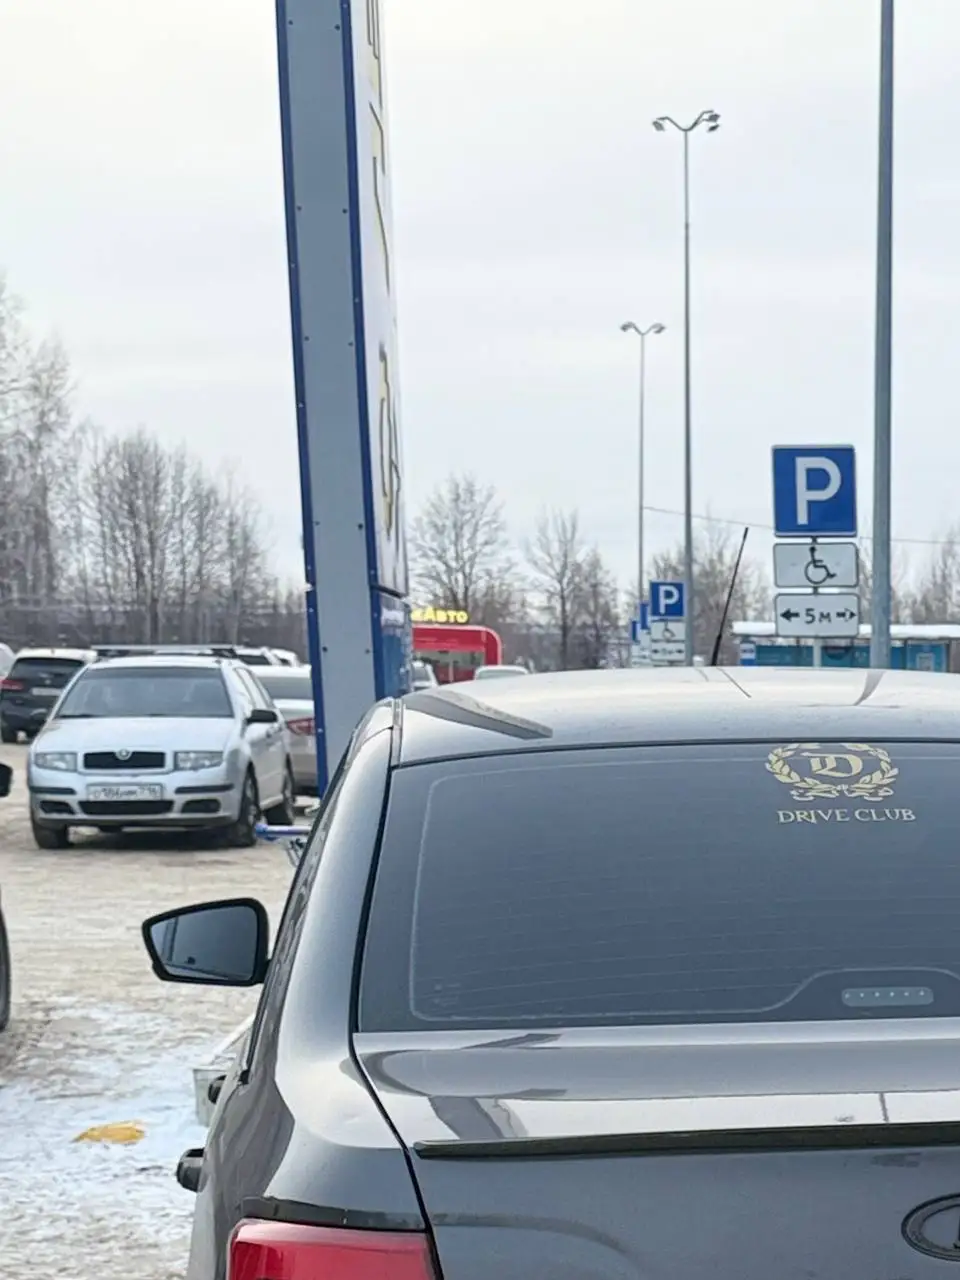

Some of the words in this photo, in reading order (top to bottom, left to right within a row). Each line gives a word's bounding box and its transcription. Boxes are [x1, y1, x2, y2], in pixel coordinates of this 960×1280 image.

[795, 456, 842, 526] P
[658, 584, 680, 615] P
[776, 808, 850, 825] DRIVE
[854, 806, 917, 822] CLUB
